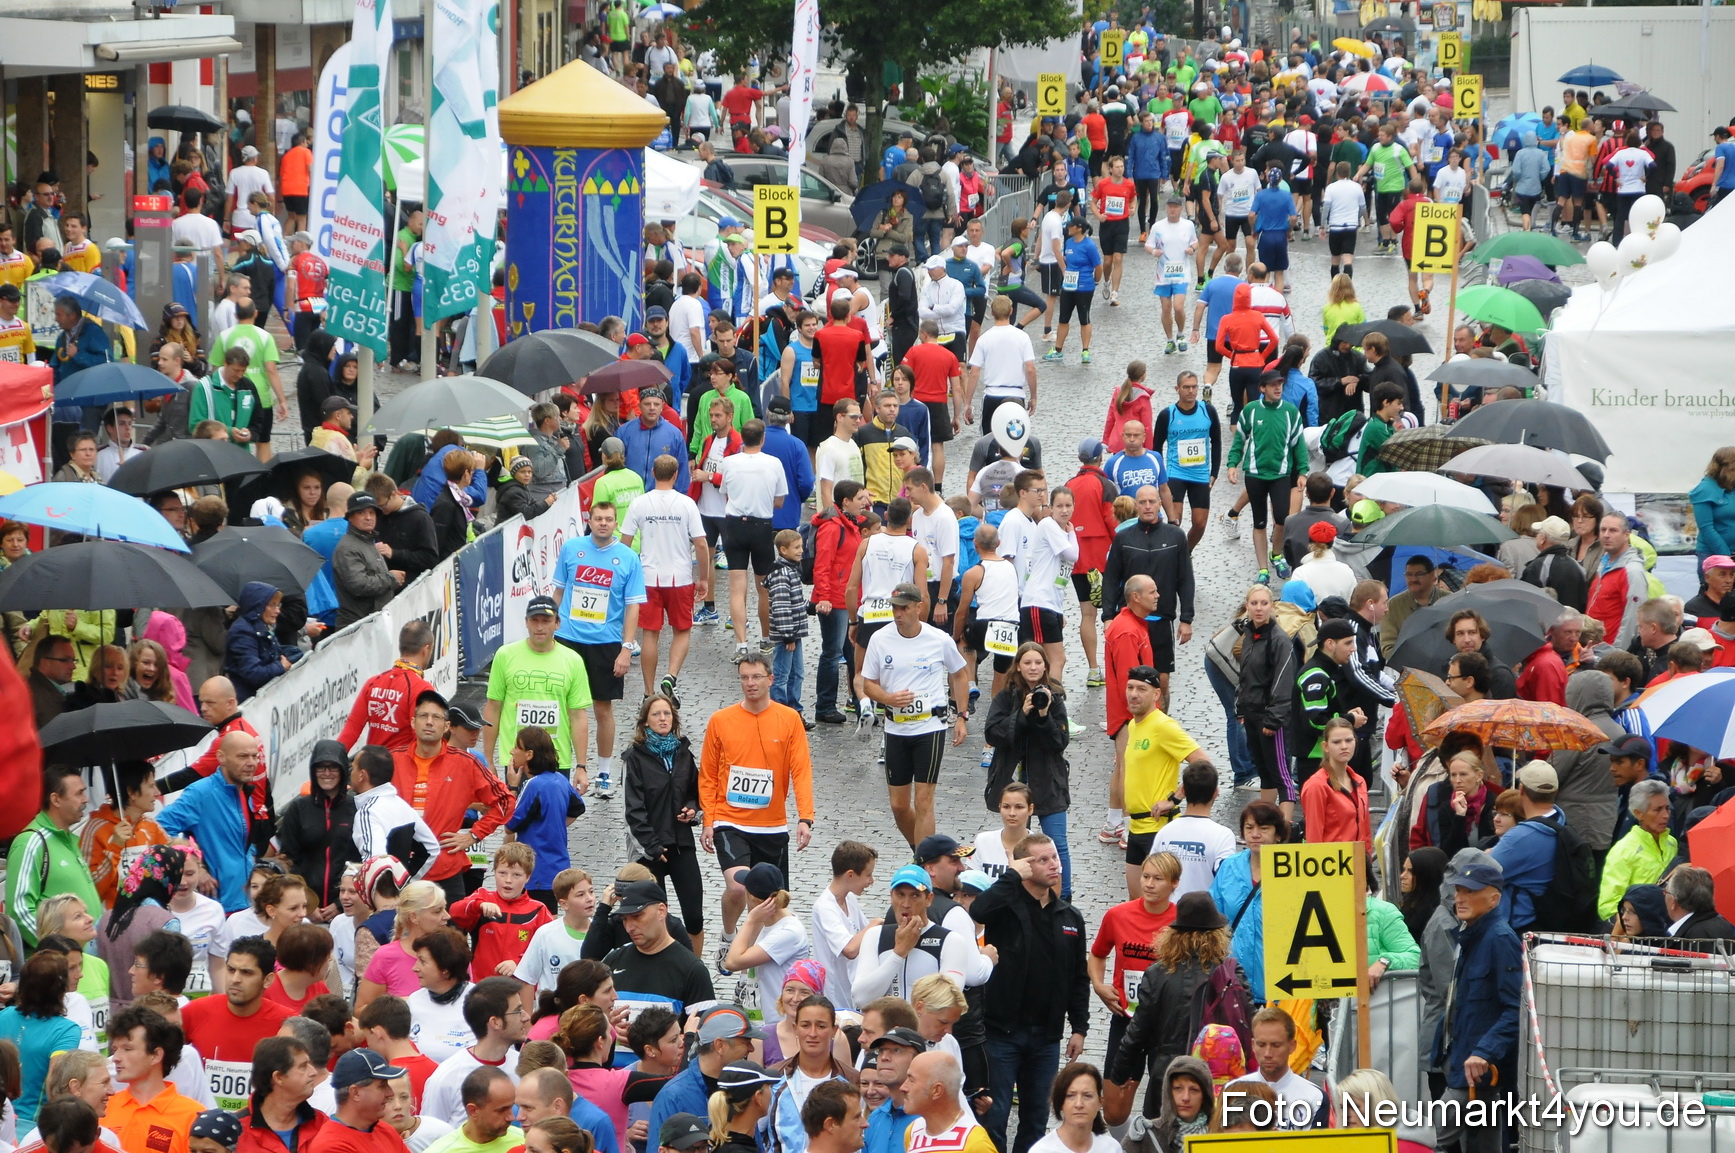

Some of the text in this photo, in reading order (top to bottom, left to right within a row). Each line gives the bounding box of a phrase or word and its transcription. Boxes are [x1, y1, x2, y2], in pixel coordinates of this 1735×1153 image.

[1103, 31, 1121, 39] Block
[1106, 41, 1117, 58] D
[1445, 43, 1456, 60] D
[1040, 74, 1063, 83] Block
[1457, 76, 1480, 85] Block
[1044, 85, 1059, 106] C
[1460, 88, 1475, 109] C
[758, 187, 794, 201] Block
[1107, 199, 1124, 209] 2048
[1421, 205, 1457, 219] Block
[765, 206, 788, 239] B
[1424, 224, 1448, 258] B
[307, 261, 322, 273] 25
[1166, 264, 1184, 273] 2346
[1591, 387, 1658, 407] Kinder
[1187, 446, 1199, 456] 69
[1123, 469, 1154, 480] Fitness
[1122, 476, 1156, 488] CORNER
[576, 567, 612, 586] Lete
[581, 596, 598, 610] 37
[995, 629, 1013, 643] 194
[513, 670, 566, 692] OPF
[521, 709, 556, 725] 5026
[731, 775, 770, 795] 2077
[737, 795, 759, 804] Roland
[1273, 849, 1354, 878] Block
[1285, 890, 1347, 965] A
[206, 1064, 225, 1073] PARTL
[210, 1073, 252, 1096] 506
[222, 1099, 242, 1110] Saad
